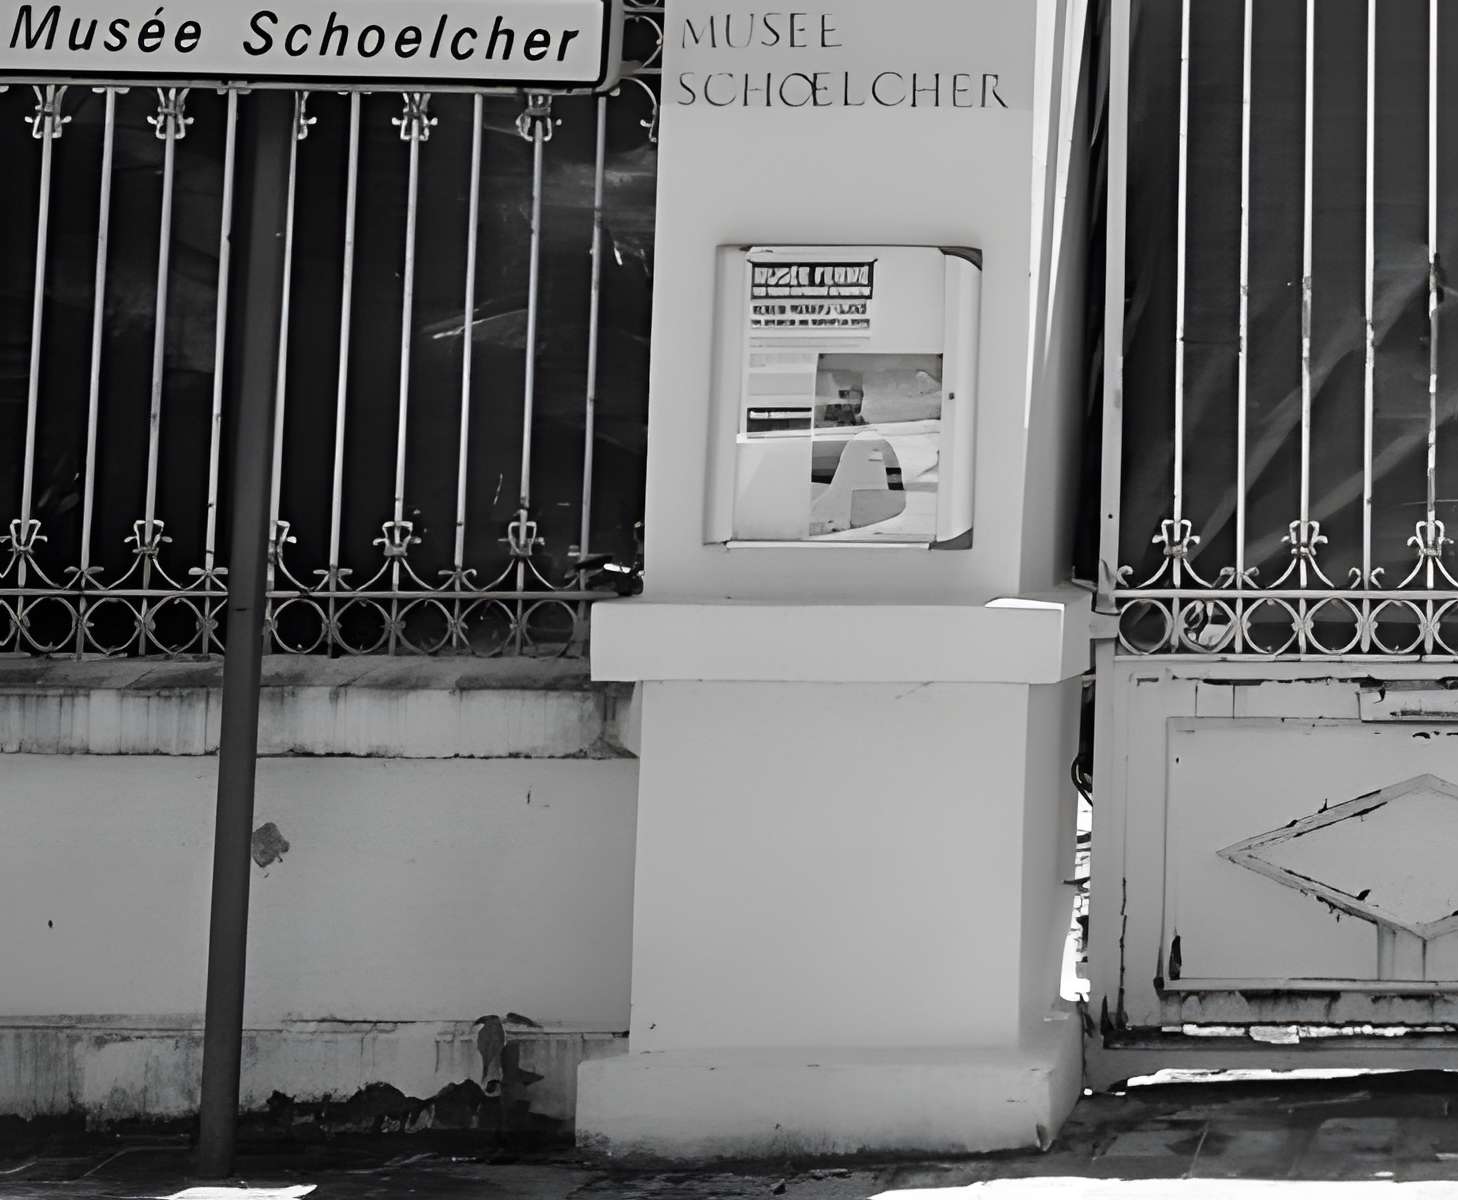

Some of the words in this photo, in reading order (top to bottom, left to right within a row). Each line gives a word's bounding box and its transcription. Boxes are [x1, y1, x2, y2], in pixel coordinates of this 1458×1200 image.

[9, 4, 202, 54] Musée
[242, 10, 580, 62] Schoelcher
[681, 12, 843, 49] MUSEE
